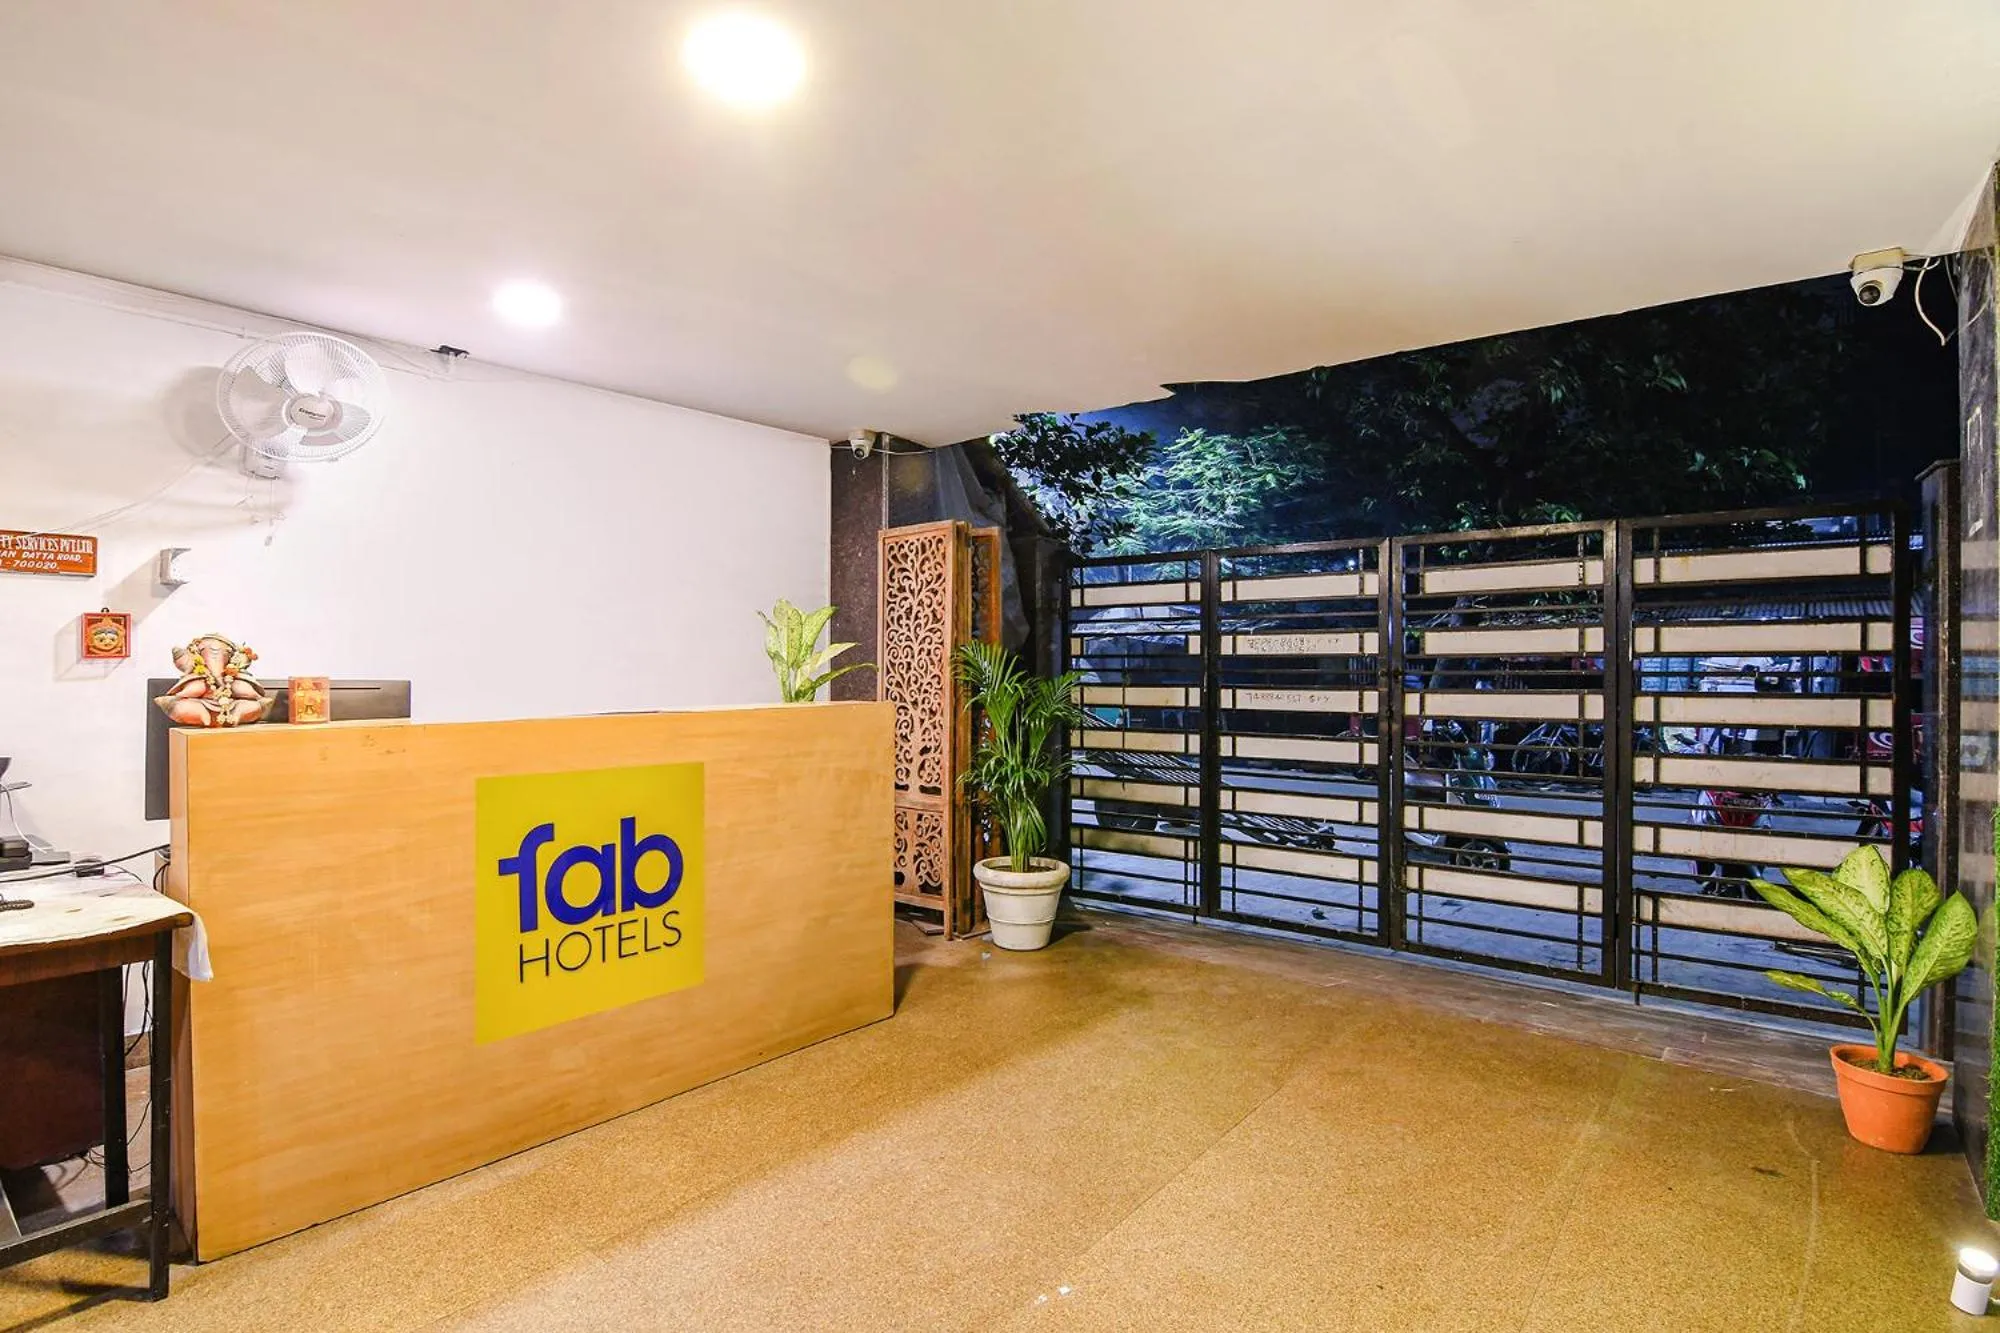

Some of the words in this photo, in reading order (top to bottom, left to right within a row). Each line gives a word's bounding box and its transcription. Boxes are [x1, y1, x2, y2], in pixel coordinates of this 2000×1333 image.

[0, 550, 17, 558] AN
[16, 535, 59, 551] SERVICES
[498, 816, 683, 933] fab
[518, 910, 682, 983] HOTELS
